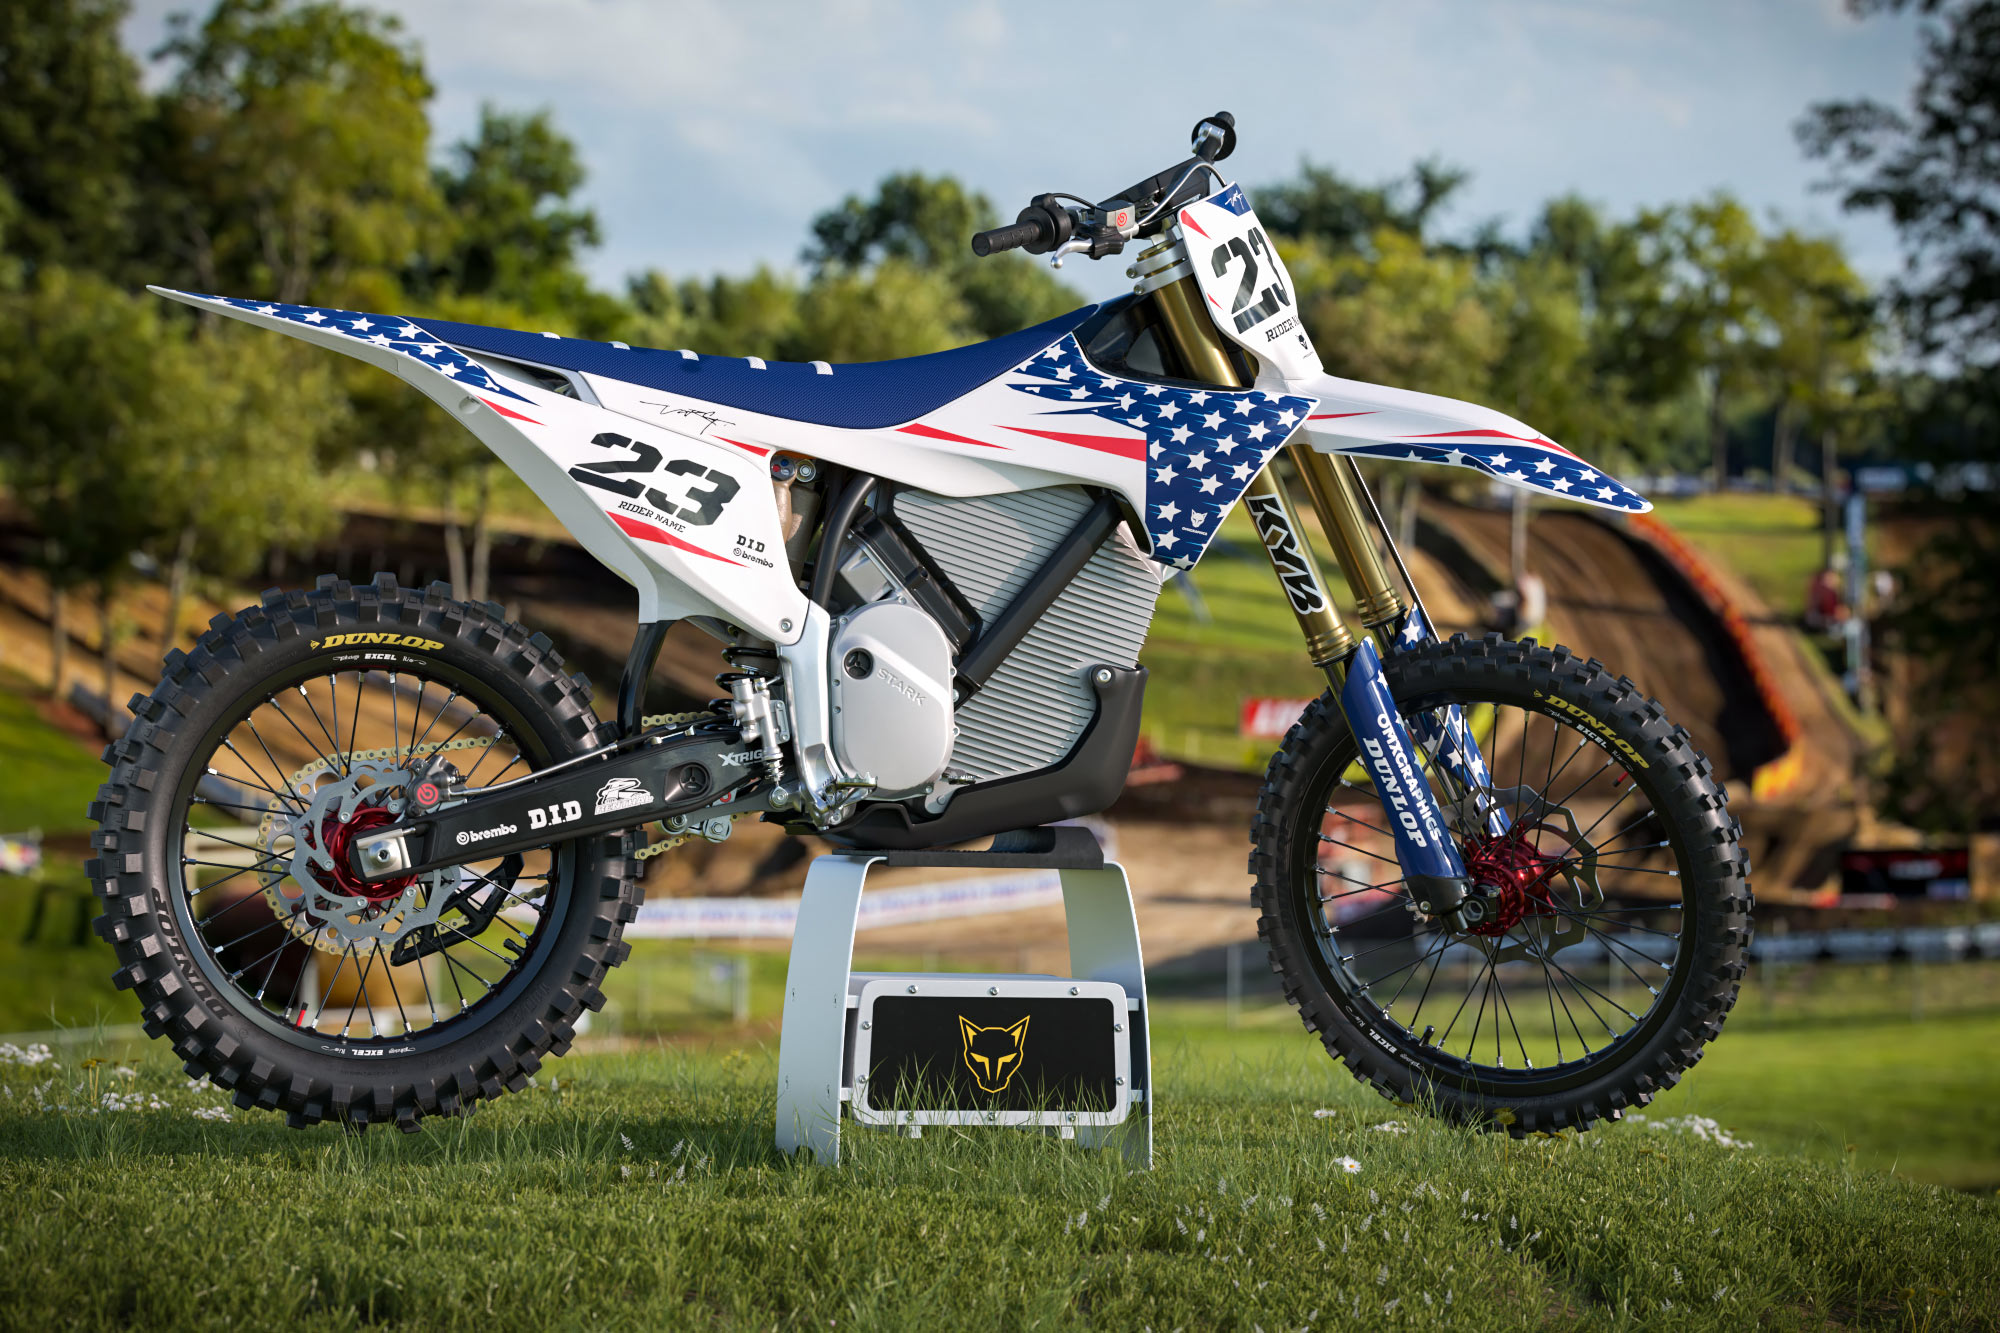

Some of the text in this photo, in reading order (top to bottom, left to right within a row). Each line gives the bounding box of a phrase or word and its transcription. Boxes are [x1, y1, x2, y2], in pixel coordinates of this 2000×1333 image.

[1265, 318, 1294, 342] RIDER
[568, 432, 741, 526] 23
[618, 500, 686, 533] RIDER NAME
[741, 550, 774, 569] brembo
[1243, 493, 1327, 615] KYB
[322, 632, 445, 651] DUNLOP
[364, 653, 397, 661] EXCEL
[877, 668, 928, 707] STARK
[1545, 694, 1650, 769] DUNLOP
[1576, 724, 1607, 748] EXCEL
[717, 749, 763, 767] XTRIG
[1377, 713, 1442, 841] OMXGRAPHICS
[1362, 737, 1427, 848] DUNLOP
[527, 800, 583, 830] D.I.D
[469, 823, 518, 842] brembo
[151, 887, 233, 1020] DUNLOP
[1368, 1028, 1398, 1054] EXCEL
